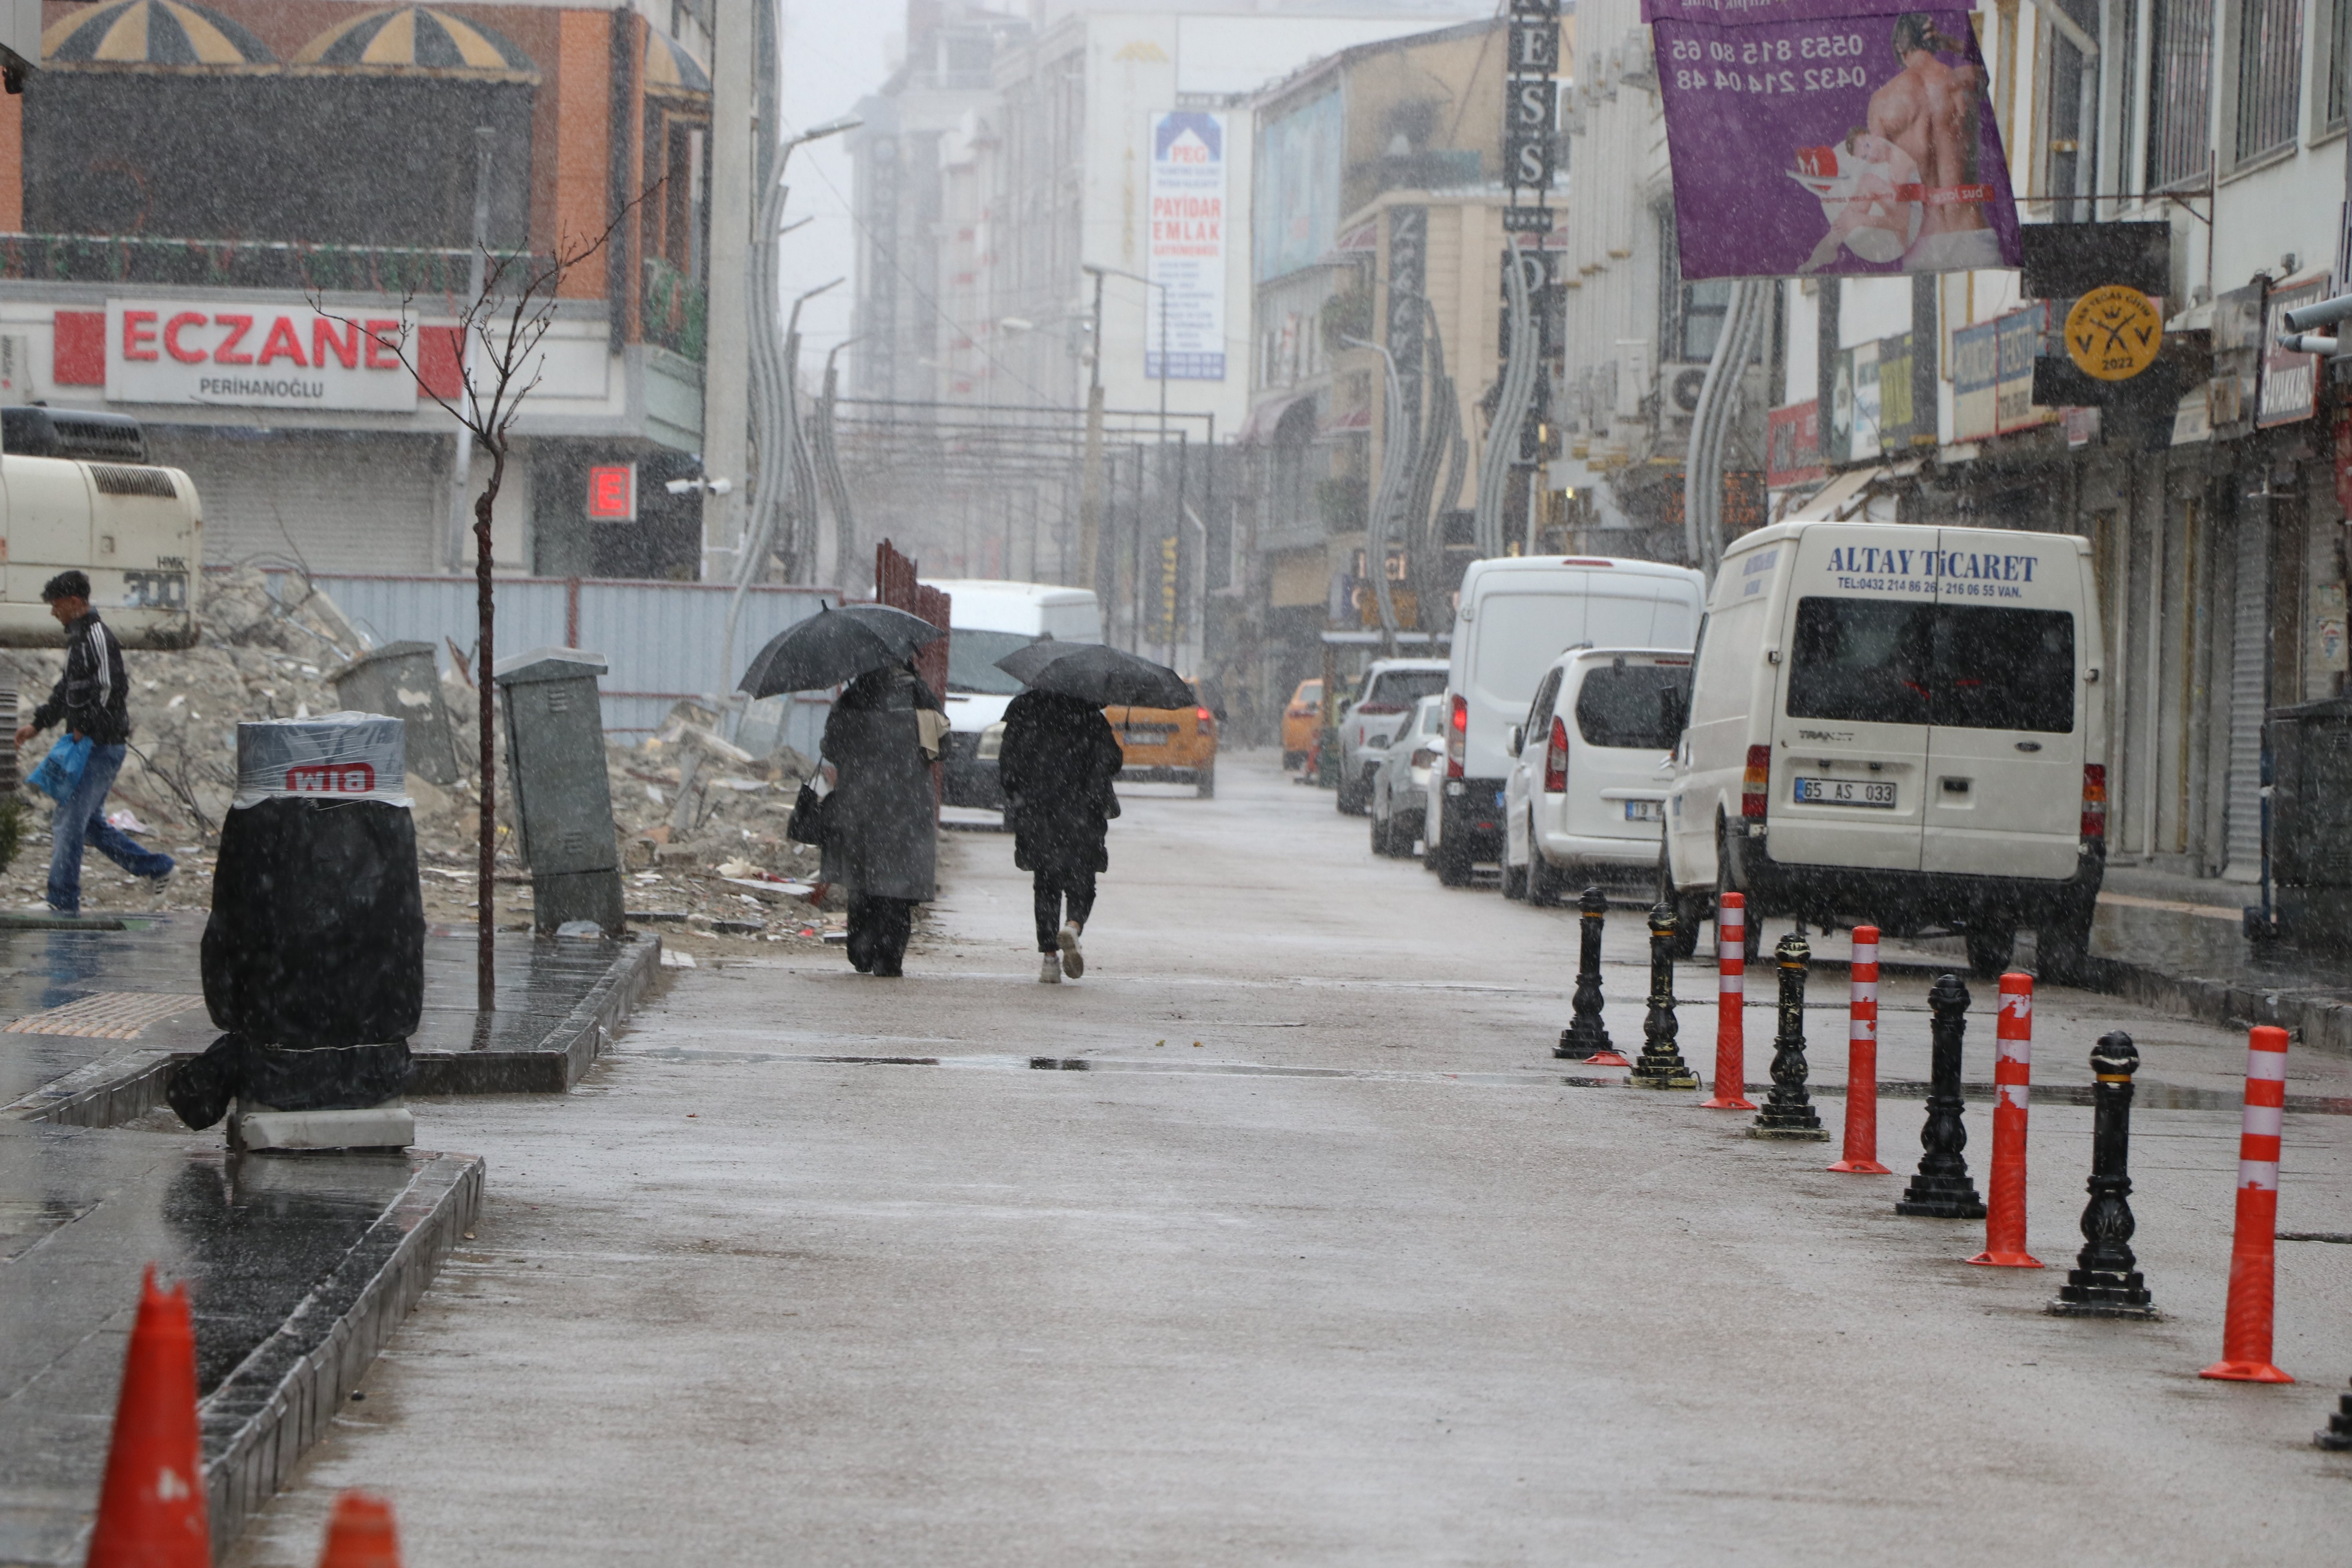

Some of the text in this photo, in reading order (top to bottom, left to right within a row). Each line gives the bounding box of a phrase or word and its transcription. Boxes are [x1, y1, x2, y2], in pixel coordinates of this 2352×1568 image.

[1518, 0, 1550, 183] ESS
[1172, 145, 1208, 163] PEG
[1153, 193, 1221, 218] PAYİDAR
[1153, 222, 1219, 240] EMLAK
[123, 310, 400, 369] ECZANE
[2075, 326, 2152, 355] V V
[2102, 357, 2134, 371] 2022
[200, 375, 324, 399] PERİHANOĞLU
[598, 474, 623, 510] E
[157, 556, 186, 570] HMK
[1827, 547, 1915, 575] ALTAY
[123, 573, 186, 607] 300
[1838, 577, 1884, 590] TEL:0432
[1888, 579, 1906, 591] 214
[1909, 580, 1920, 592] 86
[1924, 581, 1937, 593] 26
[1946, 583, 1964, 595] 216
[1967, 584, 1979, 596] 06
[1982, 584, 1994, 597] 55
[295, 769, 366, 791] BIM
[1805, 782, 1892, 801] 65 AS 033
